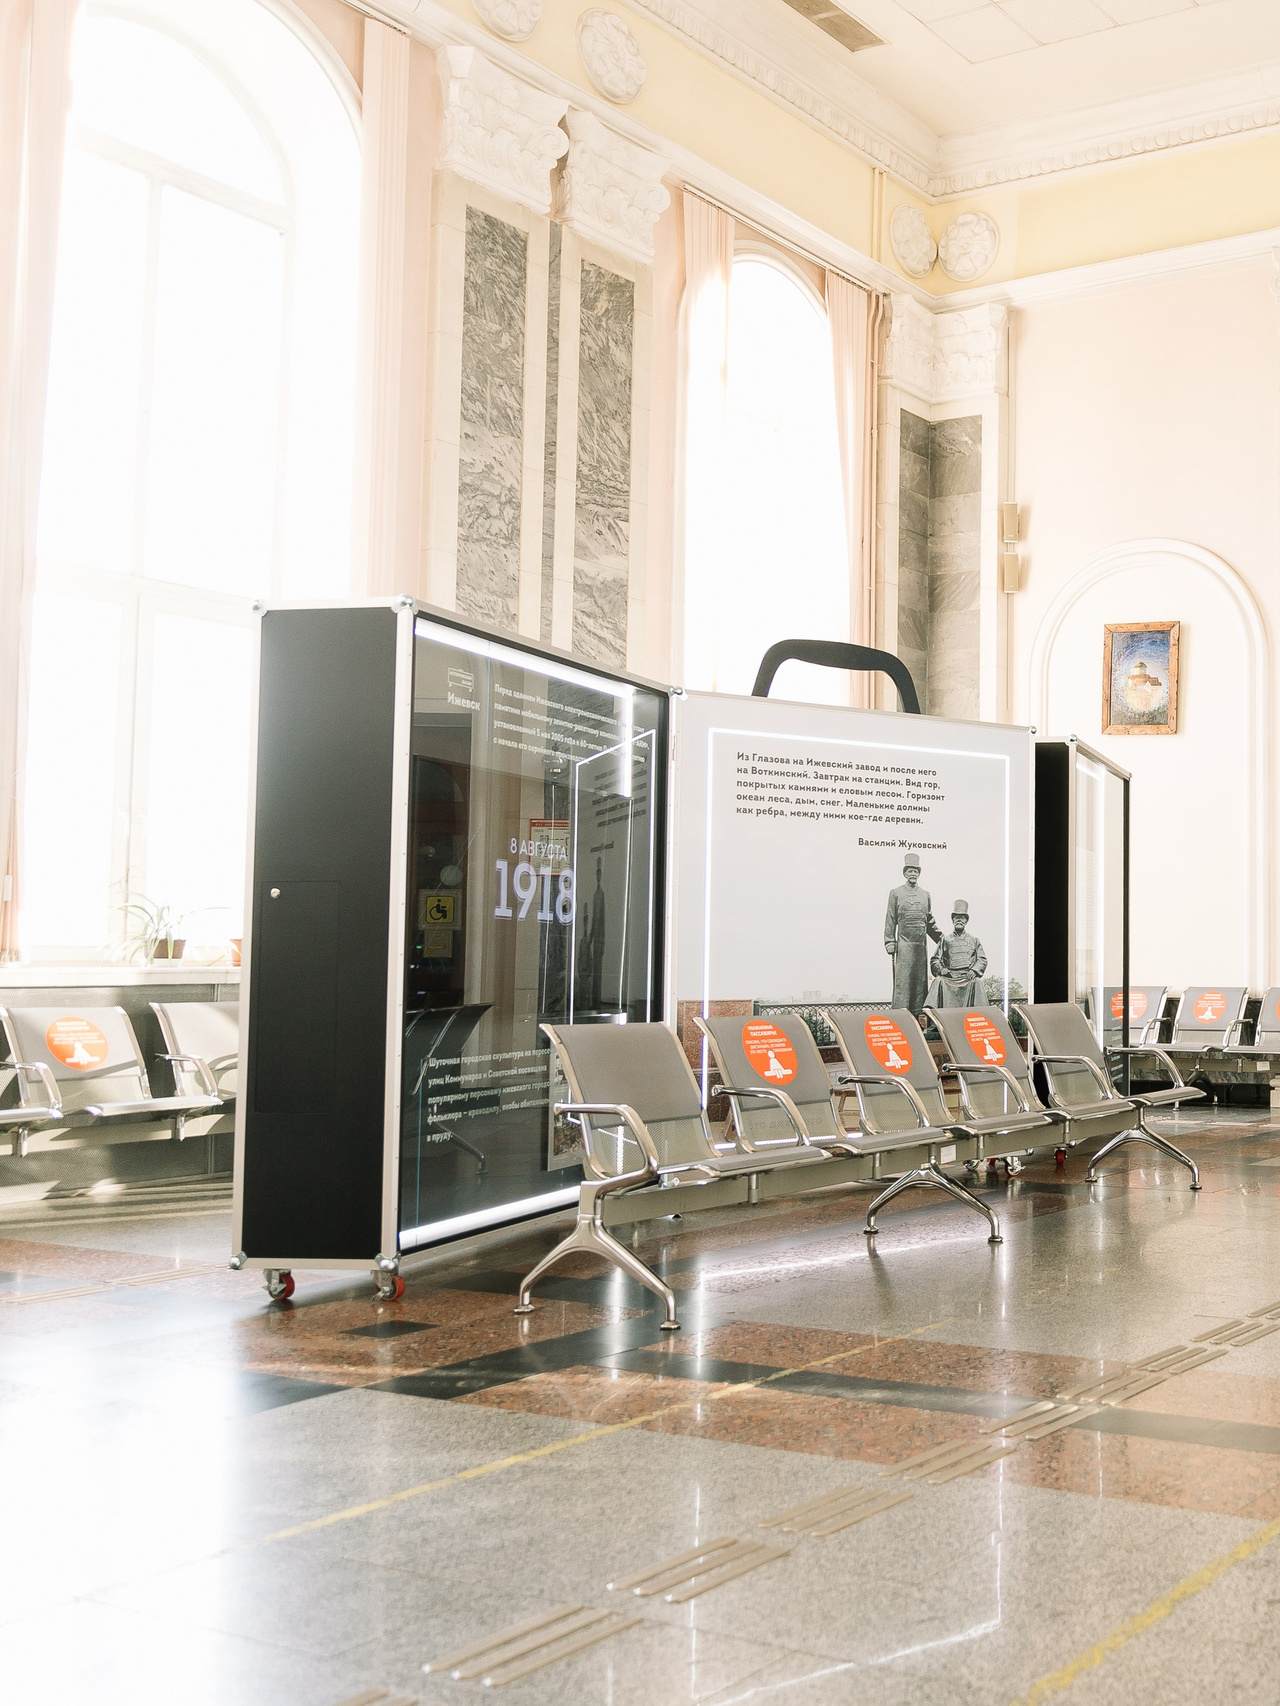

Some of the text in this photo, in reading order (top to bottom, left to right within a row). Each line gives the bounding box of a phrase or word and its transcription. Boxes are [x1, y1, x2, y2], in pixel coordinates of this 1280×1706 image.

[448, 691, 480, 711] Ижевск
[495, 683, 513, 697] Перед
[536, 728, 541, 736] 5
[737, 752, 750, 761] Из
[752, 753, 790, 764] Глазова
[806, 757, 853, 769] Ижевский
[855, 763, 881, 773] завод
[890, 766, 916, 774] после
[736, 766, 748, 774] на
[751, 766, 811, 779] Воткинский.
[813, 771, 850, 783] Завтрак
[852, 775, 863, 783] на
[864, 776, 903, 786] станции.
[905, 778, 922, 788] Вид
[736, 779, 786, 790] покрытых
[788, 783, 829, 793] камнями
[838, 786, 873, 796] еловым
[875, 791, 905, 799] лесом.
[906, 790, 945, 801] Горизонт
[736, 794, 930, 813] океан леса, дым, снег. Маленькие долины
[756, 806, 788, 818] ребра,
[790, 810, 821, 820] между
[848, 813, 883, 822] кое-где
[885, 816, 924, 825] деревни.
[510, 837, 568, 861] 8 АВГУСТА
[858, 837, 947, 850] Василий Жуковский
[494, 858, 577, 925] 1918
[429, 1057, 460, 1069] Шуточная
[461, 1054, 491, 1065] городская
[492, 1050, 524, 1062] скульптура
[428, 1078, 444, 1088] улиц
[445, 1073, 482, 1083] Коммунаров
[488, 1067, 517, 1078] Советской
[518, 1065, 547, 1074] посвящена
[428, 1092, 469, 1105] популярному
[470, 1088, 501, 1100] персонажу
[502, 1083, 531, 1094] ижевского
[427, 1111, 462, 1125] фольклора
[502, 1100, 520, 1111] якобы
